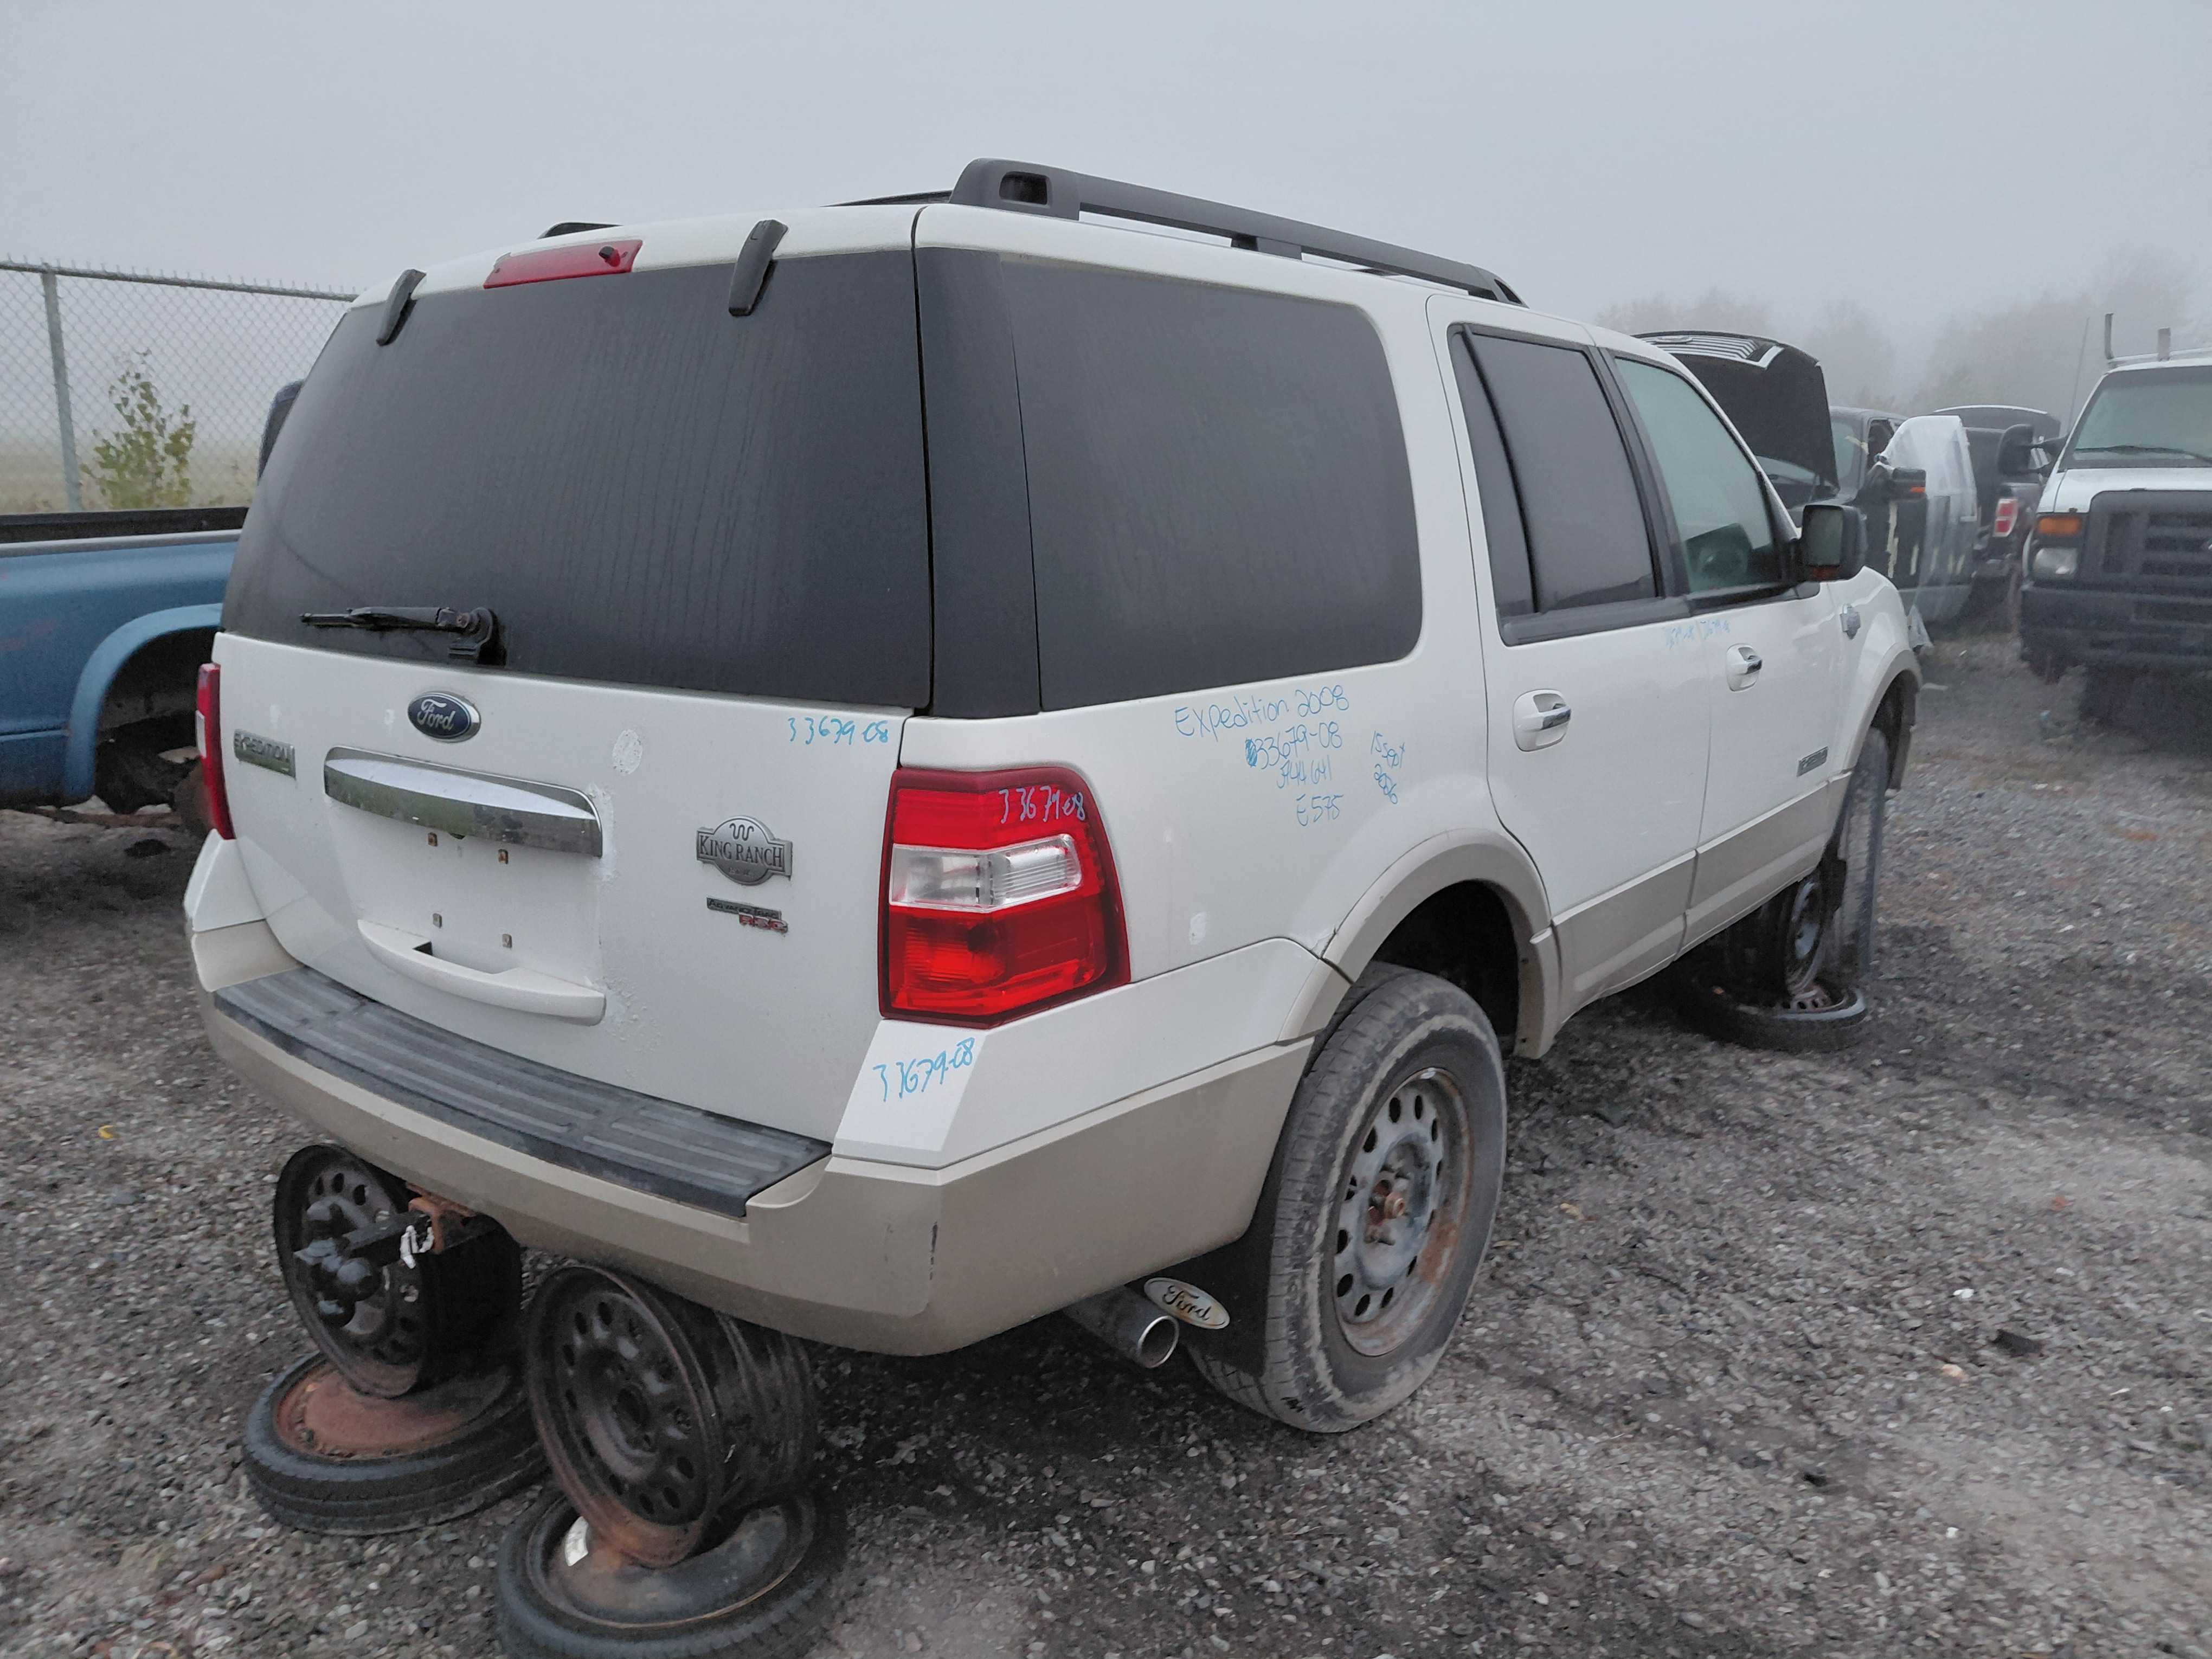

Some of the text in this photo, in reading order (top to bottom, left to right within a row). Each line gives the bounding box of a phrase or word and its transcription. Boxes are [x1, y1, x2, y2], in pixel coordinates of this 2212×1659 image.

[417, 698, 456, 730] Ford
[1295, 685, 1349, 717] 2008
[700, 835, 782, 868] KING RANCH
[1162, 1285, 1212, 1321] Ford
